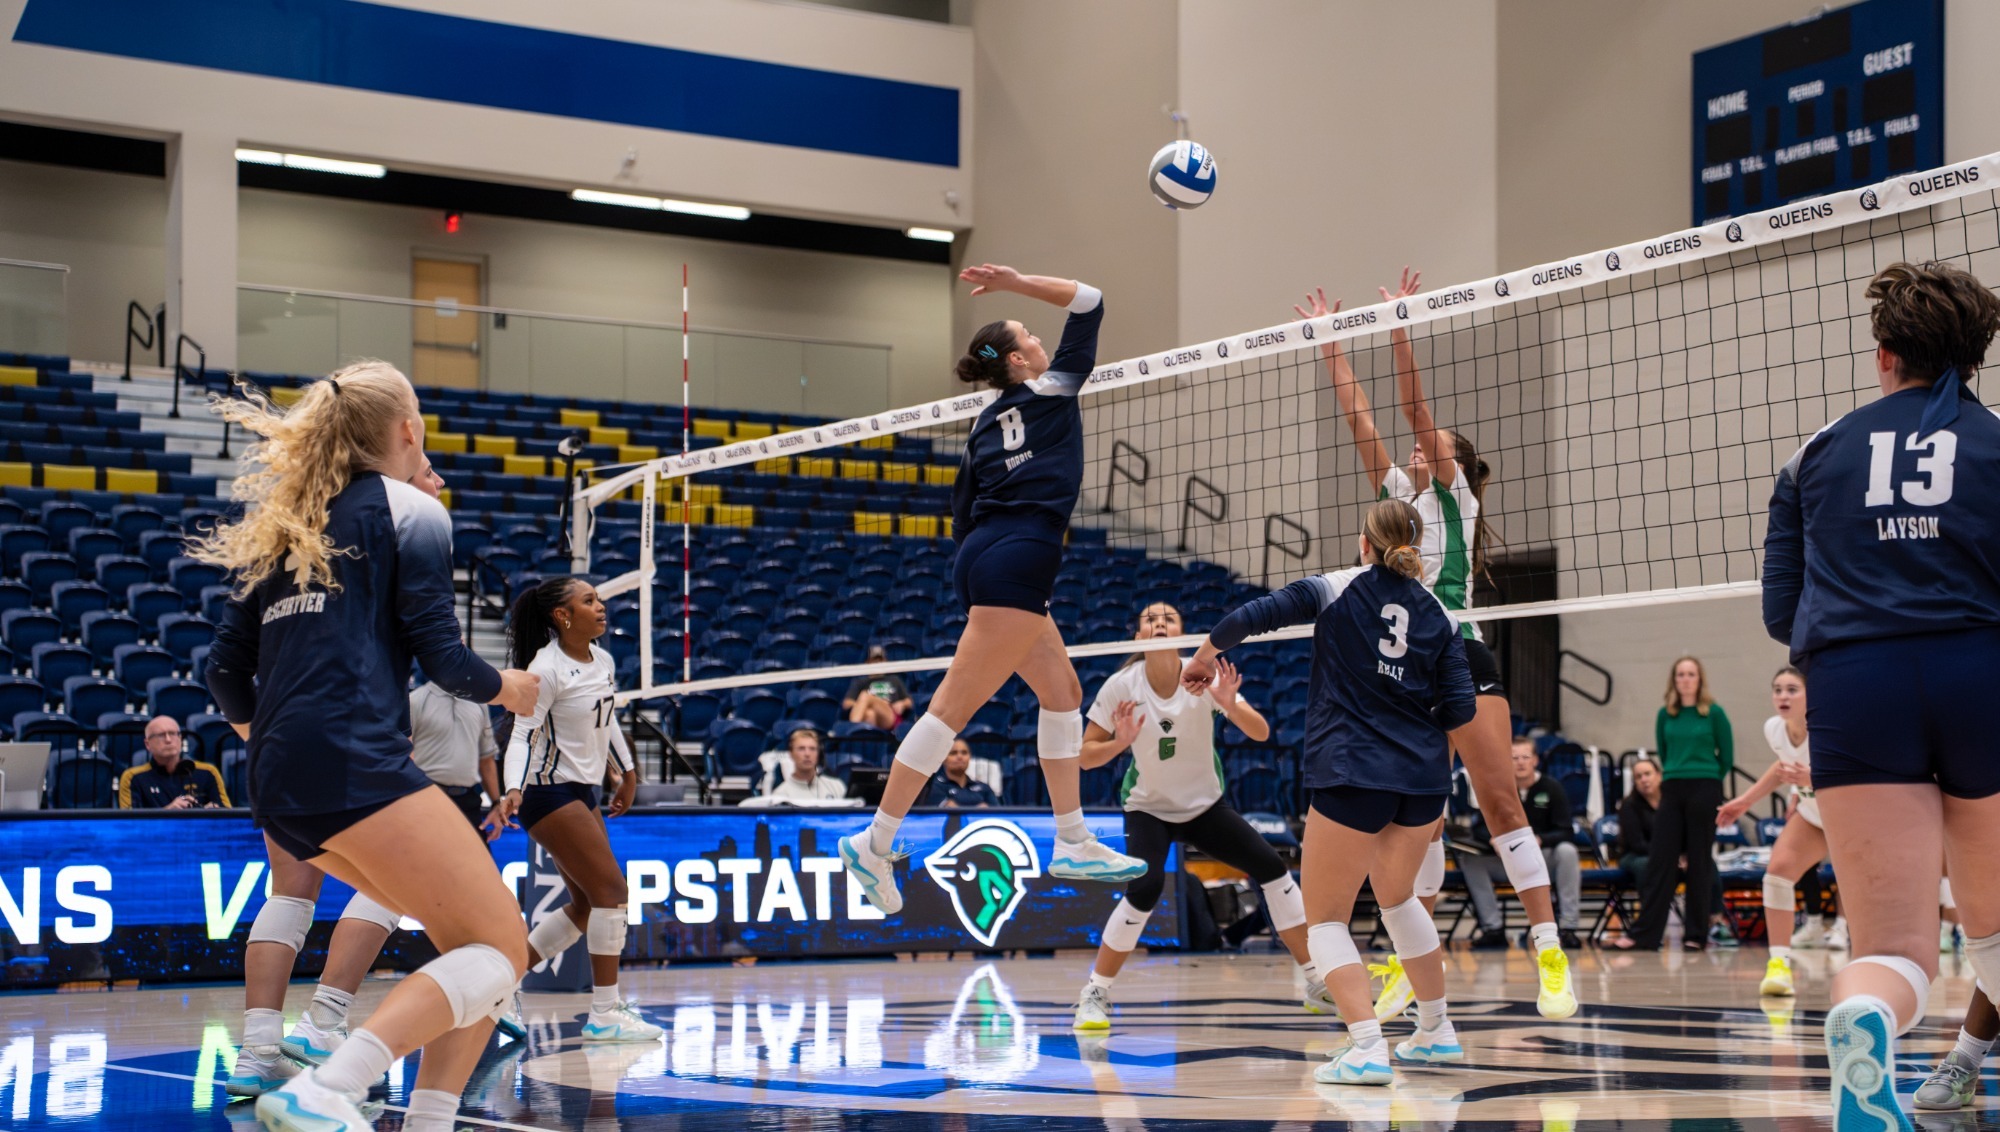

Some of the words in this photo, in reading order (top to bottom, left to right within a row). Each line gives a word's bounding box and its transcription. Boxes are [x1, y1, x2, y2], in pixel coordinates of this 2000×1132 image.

[1863, 41, 1914, 76] GUEST
[1707, 89, 1748, 120] HOME
[1788, 79, 1825, 103] PERIOD
[1701, 162, 1733, 184] FOULS
[1775, 141, 1812, 166] PLAYER
[1813, 135, 1840, 155] FOUL
[1884, 114, 1919, 138] FOULS
[1088, 367, 1124, 384] QUEENS
[1164, 350, 1201, 367] QUEENS
[1245, 332, 1285, 349] QUEENS
[1332, 312, 1376, 331] QUEENS
[1427, 289, 1475, 310] QUEENS
[1532, 263, 1582, 286] QUEENS
[1643, 234, 1701, 259] QUEENS
[1769, 203, 1833, 229] QUEENS
[1909, 166, 1979, 196] QUEENS
[778, 435, 804, 448] QUEENS
[833, 423, 861, 437] QUEENS
[891, 411, 921, 425] QUEENS
[952, 397, 983, 411] QUEENS
[1005, 450, 1034, 472] NORRIS
[1865, 429, 1957, 507] 13
[1877, 516, 1940, 541] LAYSON
[1378, 603, 1409, 659] 3
[591, 695, 615, 729] 17
[1158, 736, 1177, 761] 6
[0, 865, 113, 945] NS
[627, 858, 887, 926] PSTATE
